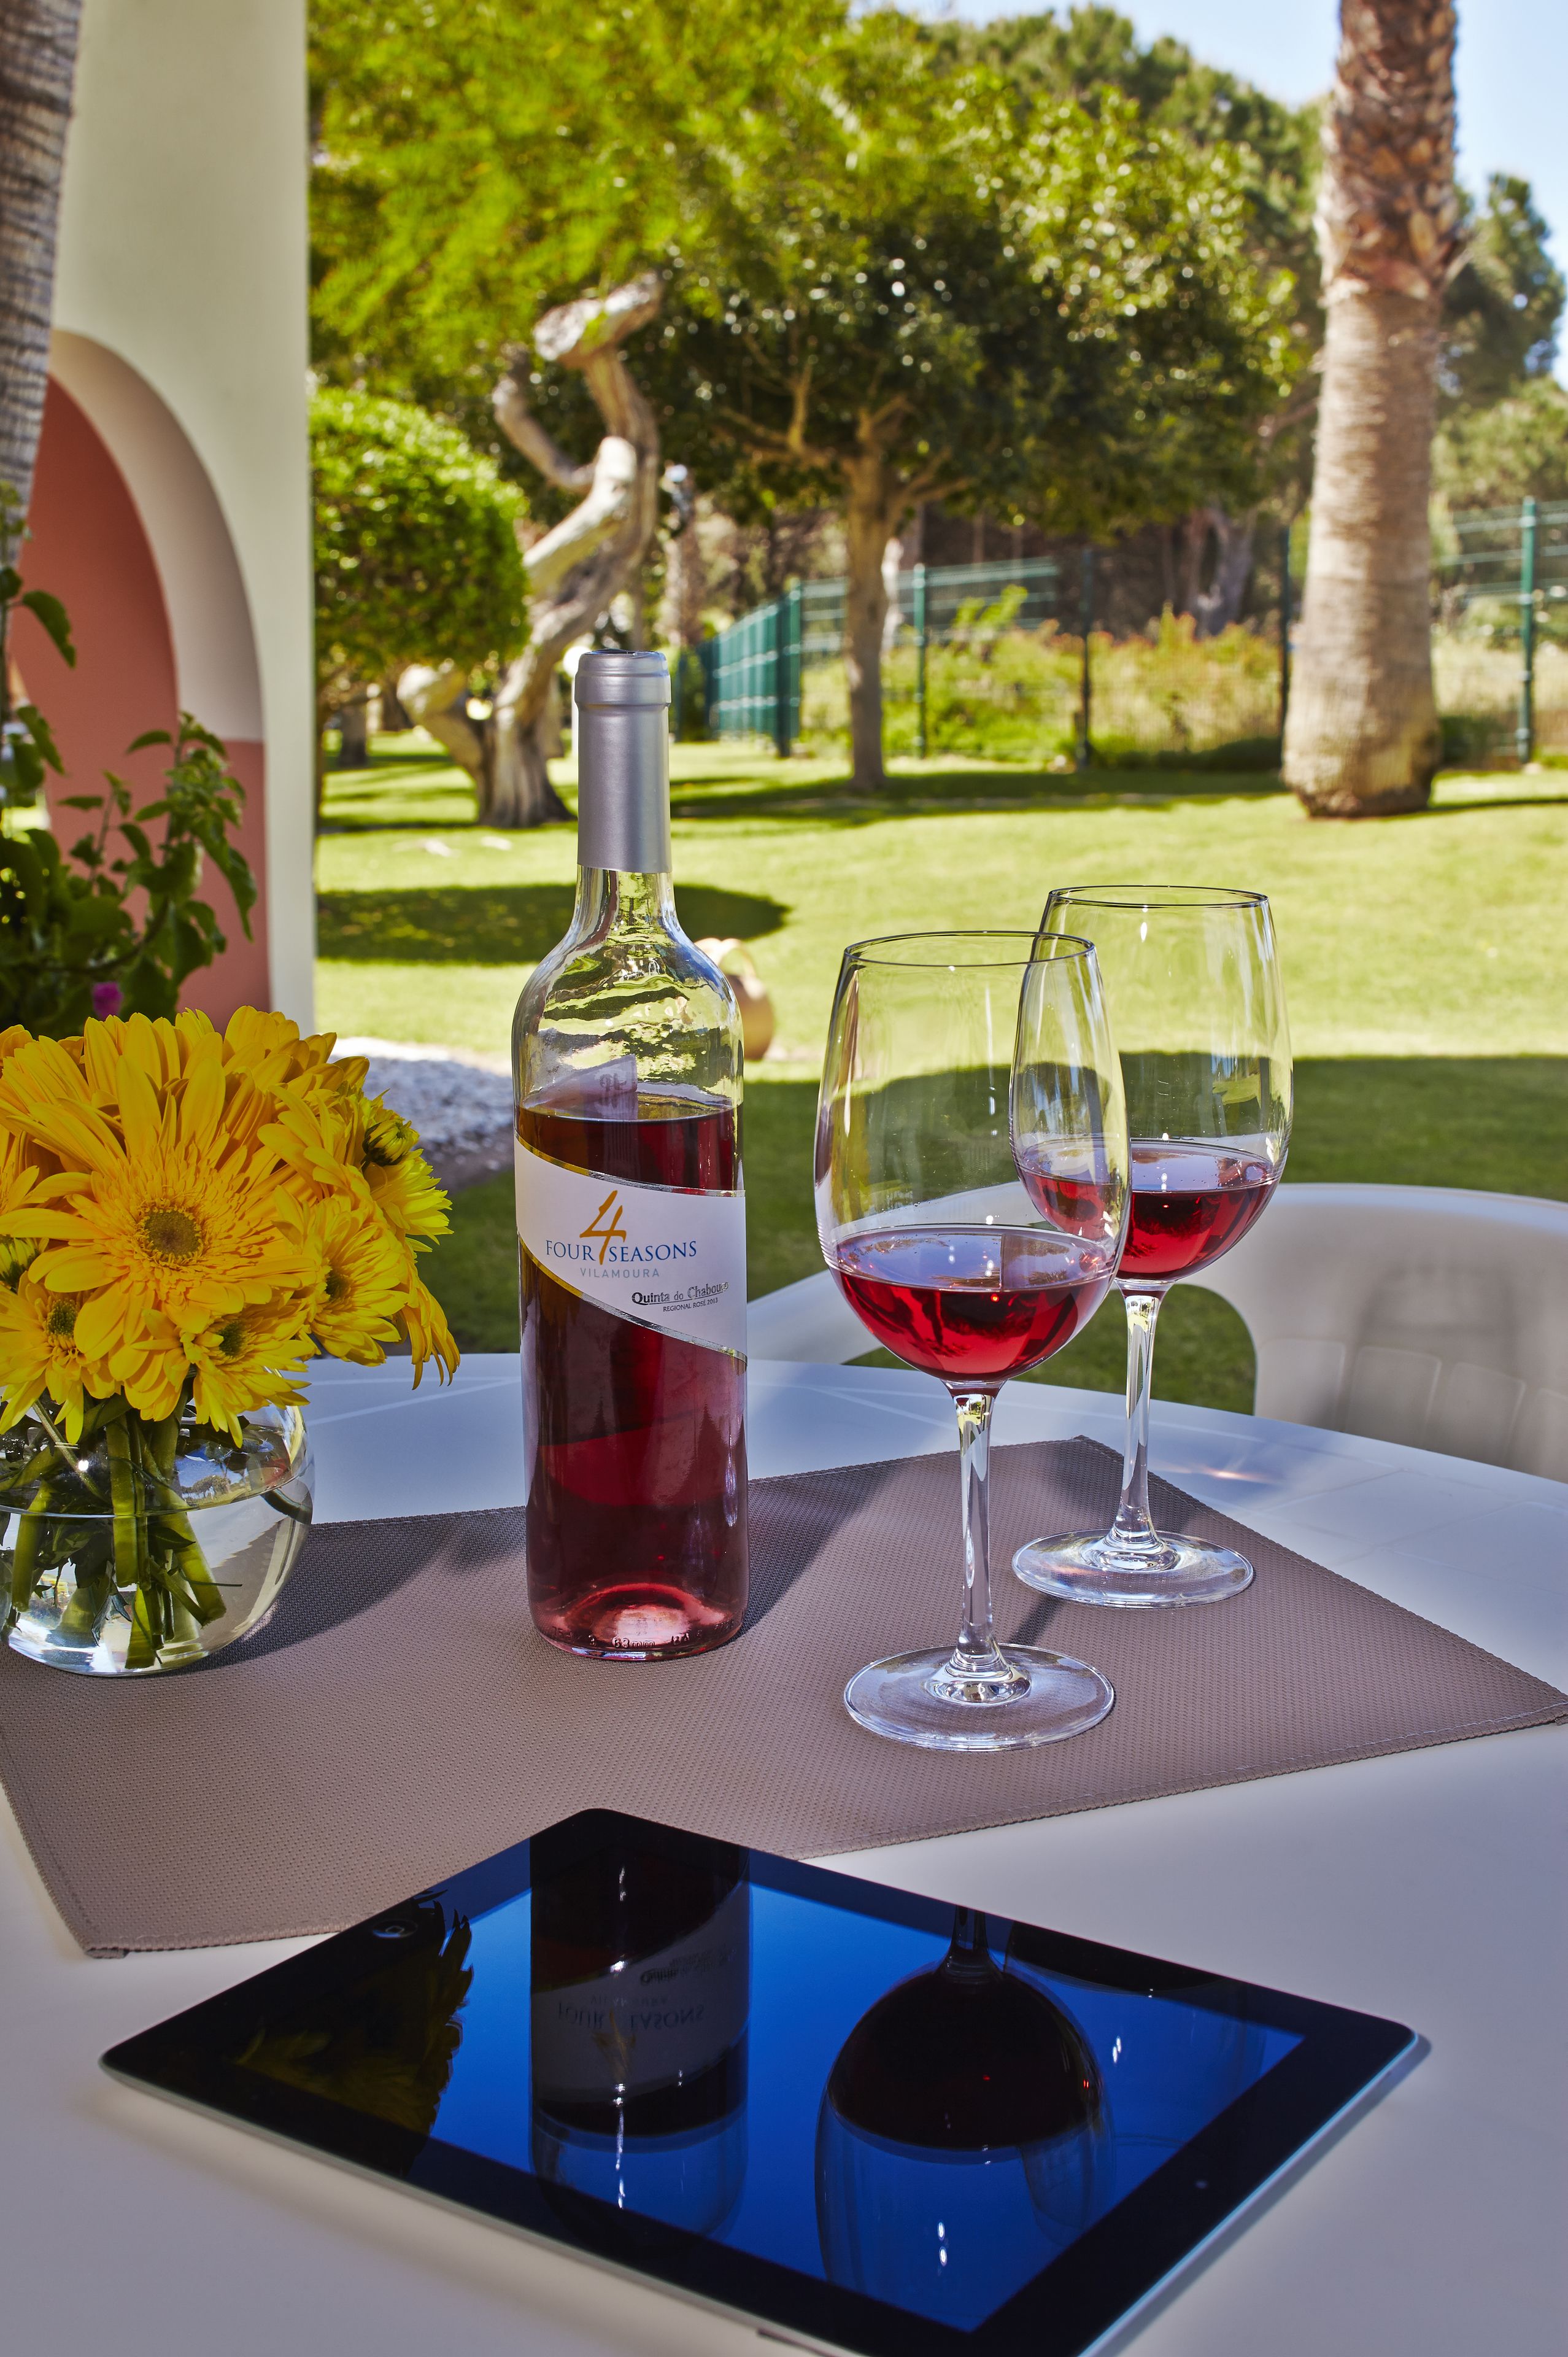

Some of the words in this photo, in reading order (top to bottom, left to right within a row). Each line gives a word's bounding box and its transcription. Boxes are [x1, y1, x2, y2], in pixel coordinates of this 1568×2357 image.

[579, 1190, 627, 1265] 4
[546, 1239, 596, 1261] FOUR
[609, 1240, 697, 1262] SEASONS
[580, 1268, 660, 1278] VILAMOURA
[631, 1292, 670, 1306] Quinta
[674, 1291, 684, 1301] do
[663, 1302, 691, 1312] REGIONAL
[693, 1299, 706, 1308] ROSÉ
